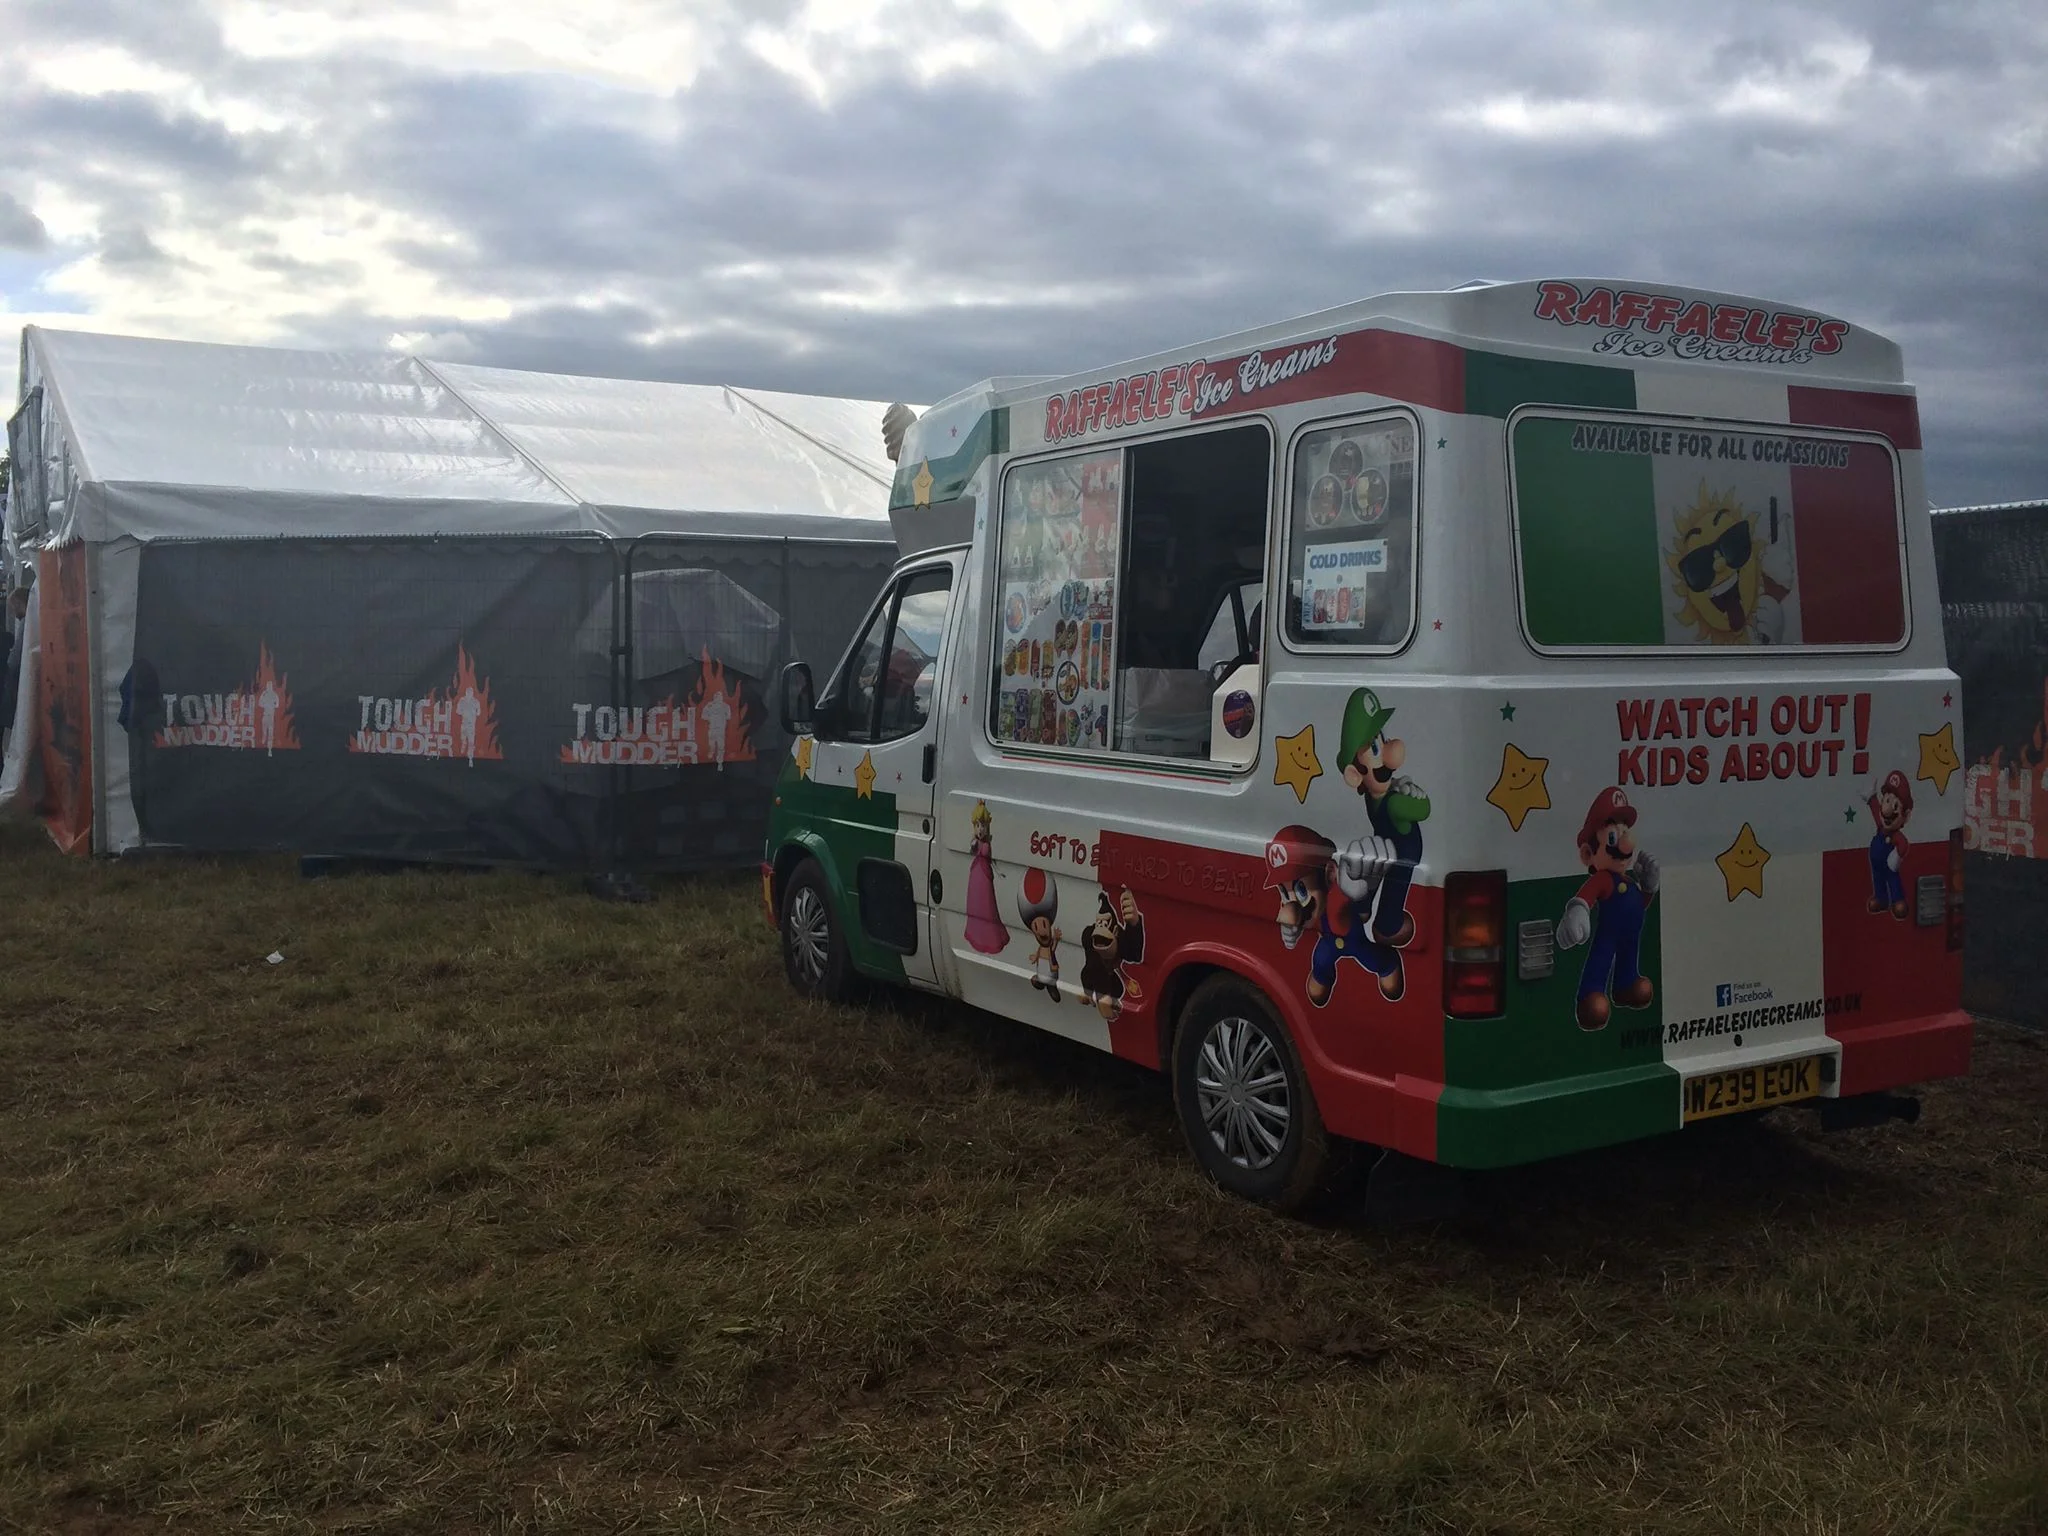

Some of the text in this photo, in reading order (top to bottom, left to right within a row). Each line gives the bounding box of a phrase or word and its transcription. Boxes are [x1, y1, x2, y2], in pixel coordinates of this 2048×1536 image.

[1534, 280, 1850, 356] RAFFAELE'S
[1593, 330, 1812, 364] Ice Creams
[1043, 335, 1338, 443] RAFFAELE'S Ice Creams
[1570, 424, 1850, 469] AVAILABLE FOR ALL OCCASSIONS
[1309, 550, 1382, 570] COLD DRINKS
[162, 691, 256, 727] TOUGH
[357, 695, 453, 734] TOUGH
[571, 703, 697, 743] TOUGH
[1616, 696, 1758, 742] WATCH
[162, 725, 256, 749] MUDDER
[356, 730, 454, 757] MUDDER
[571, 740, 699, 765] MUDDER
[1618, 746, 1710, 787] KIDS
[1030, 831, 1067, 860] SOFT
[1069, 839, 1087, 865] TO
[1124, 853, 1170, 881] HARD
[1177, 861, 1195, 887] TO
[1201, 865, 1256, 899] BEAT!
[1734, 988, 1774, 1003] Facebook
[1692, 1059, 1811, 1114] W239 EOK
